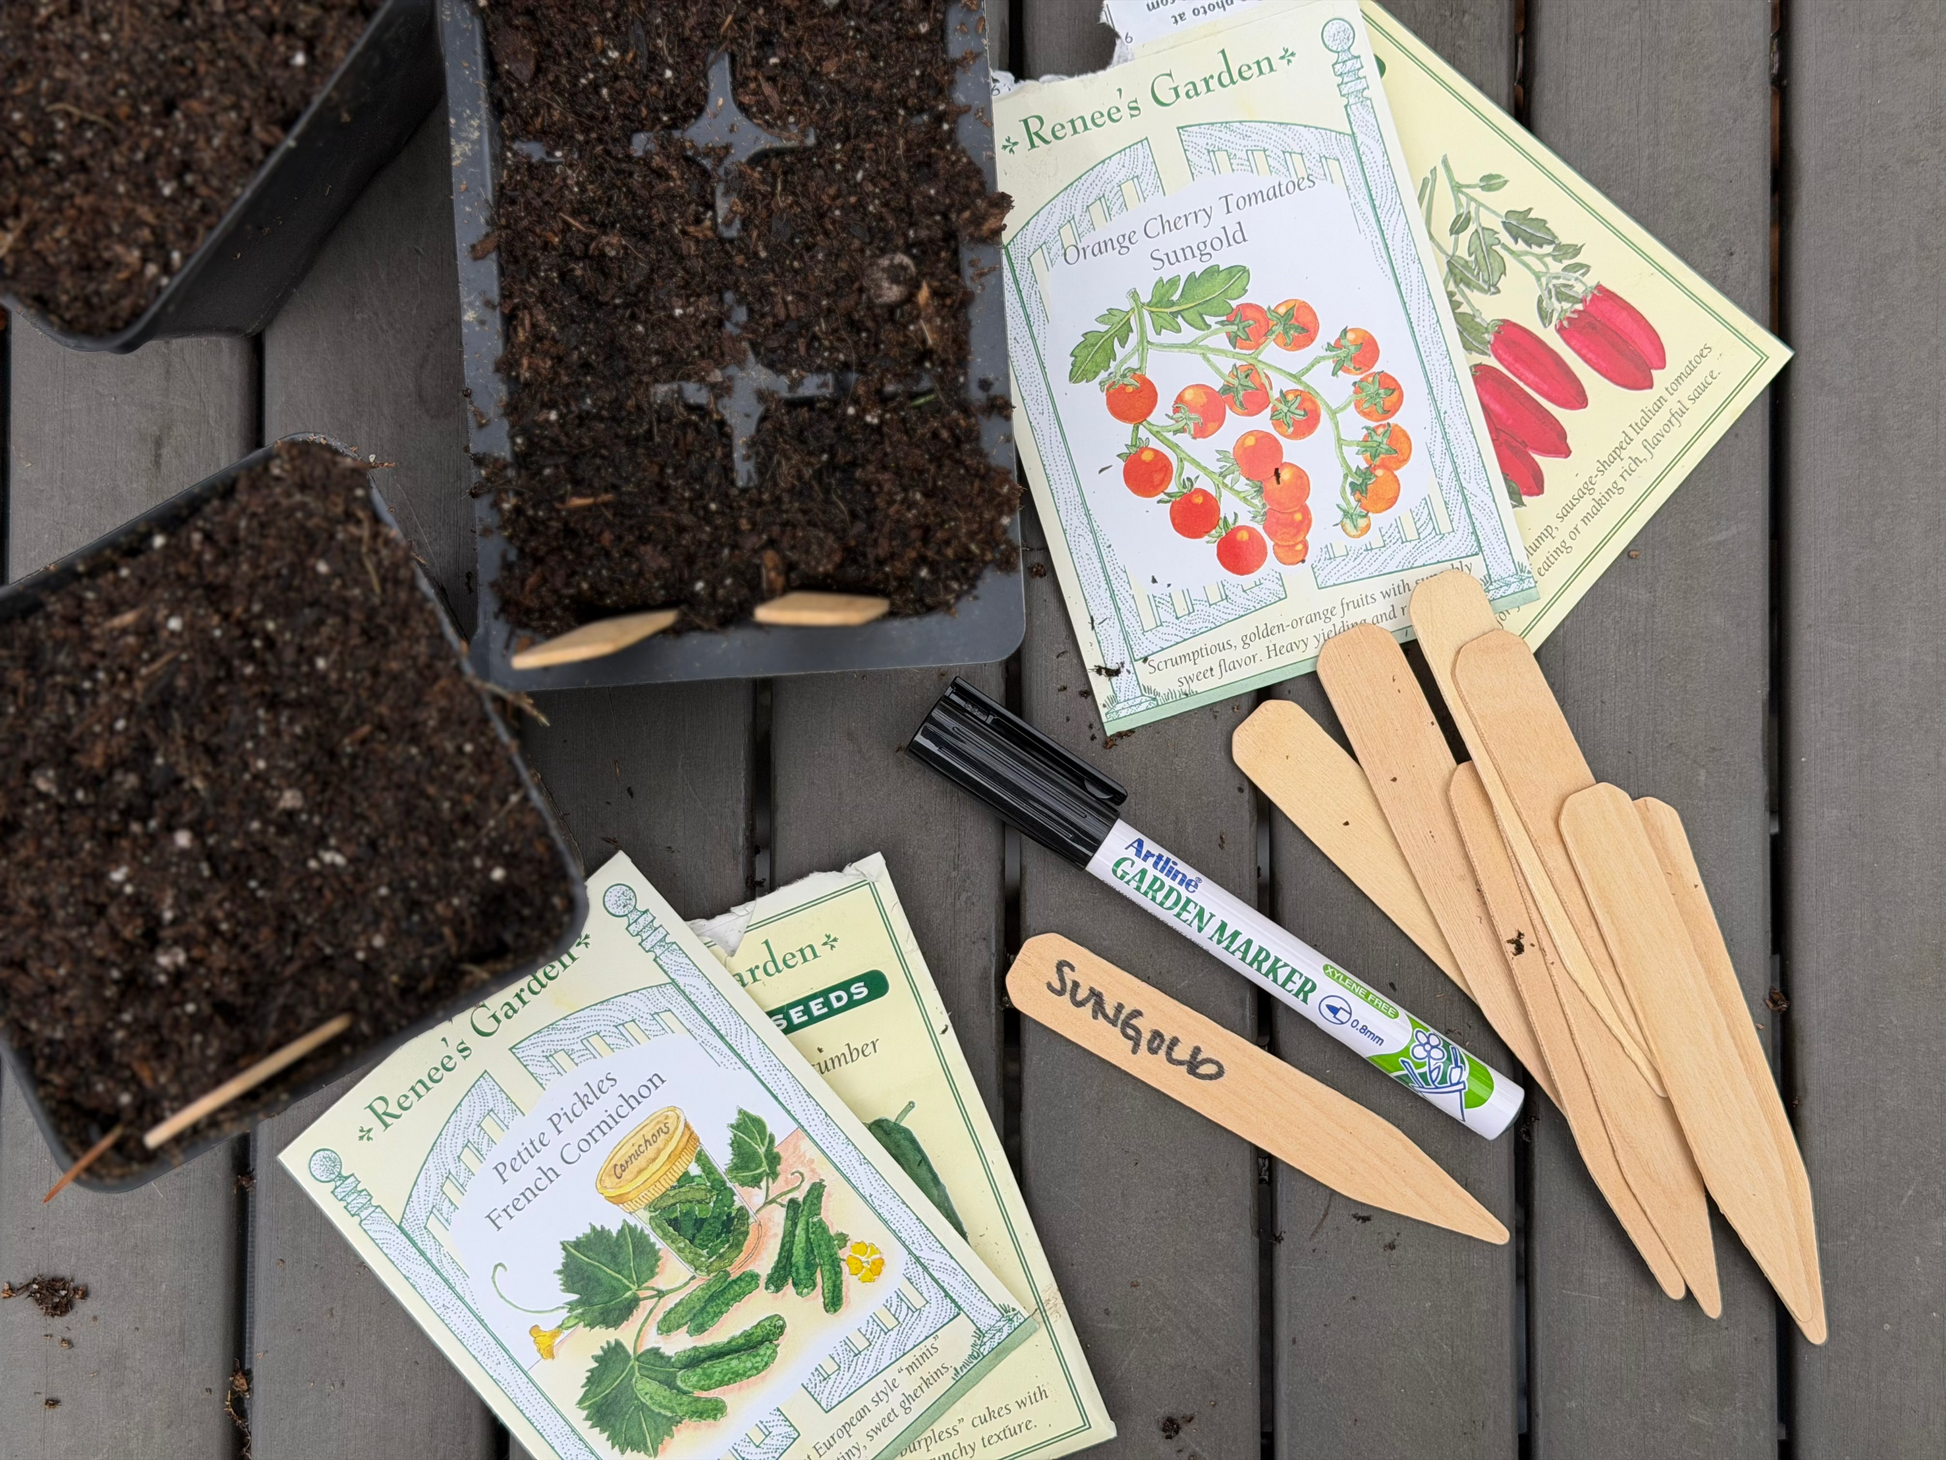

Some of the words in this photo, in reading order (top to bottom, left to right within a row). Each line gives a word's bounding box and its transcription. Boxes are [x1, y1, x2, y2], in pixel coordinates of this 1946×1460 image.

[1170, 11, 1187, 26] at
[1018, 88, 1142, 152] Renee's
[1150, 48, 1278, 107] Garden
[1063, 229, 1138, 267] Orange
[1143, 206, 1213, 243] Cherry
[1218, 173, 1317, 216] Tomatoes
[1149, 221, 1249, 272] Sungold
[1523, 524, 1559, 558] lump,
[1555, 430, 1634, 523] sausage-shaped
[1628, 394, 1668, 436] Italian
[1664, 343, 1713, 397] tomatoes
[1536, 539, 1573, 577] eating
[1568, 524, 1581, 541] or
[1581, 479, 1626, 527] making
[1620, 449, 1648, 483] rich,
[1640, 400, 1690, 459] flavorful
[1687, 369, 1722, 405] sauce.
[1148, 640, 1237, 674] Scrumptious,
[1241, 607, 1338, 650] golden-orange
[1339, 592, 1377, 619] fruits
[1379, 577, 1412, 601] with
[1177, 667, 1215, 687] sweet
[1218, 654, 1263, 680] flavor.
[1265, 637, 1309, 660] Heavy
[1371, 604, 1398, 626] and
[731, 938, 822, 989] arden
[1111, 857, 1216, 934] GARDEN
[1207, 919, 1318, 1006] MARKER
[769, 981, 869, 1031] SEEDS
[1325, 965, 1366, 997] XYLENE
[1367, 992, 1397, 1018] FREE
[1350, 1018, 1385, 1047] 0.8mm
[363, 1036, 472, 1133] Renee's
[470, 950, 580, 1038] Garden
[484, 1165, 562, 1232] French
[559, 1072, 668, 1165] Cornichon
[491, 1131, 551, 1185] Petite
[546, 1071, 618, 1136] Pickles
[811, 1402, 872, 1459] European
[871, 1377, 900, 1407] style
[865, 1407, 900, 1442] sweet
[899, 1362, 953, 1415] gherkins.
[971, 1403, 1012, 1428] cukes
[1014, 1385, 1049, 1410] with
[980, 1418, 1038, 1449] texture.
